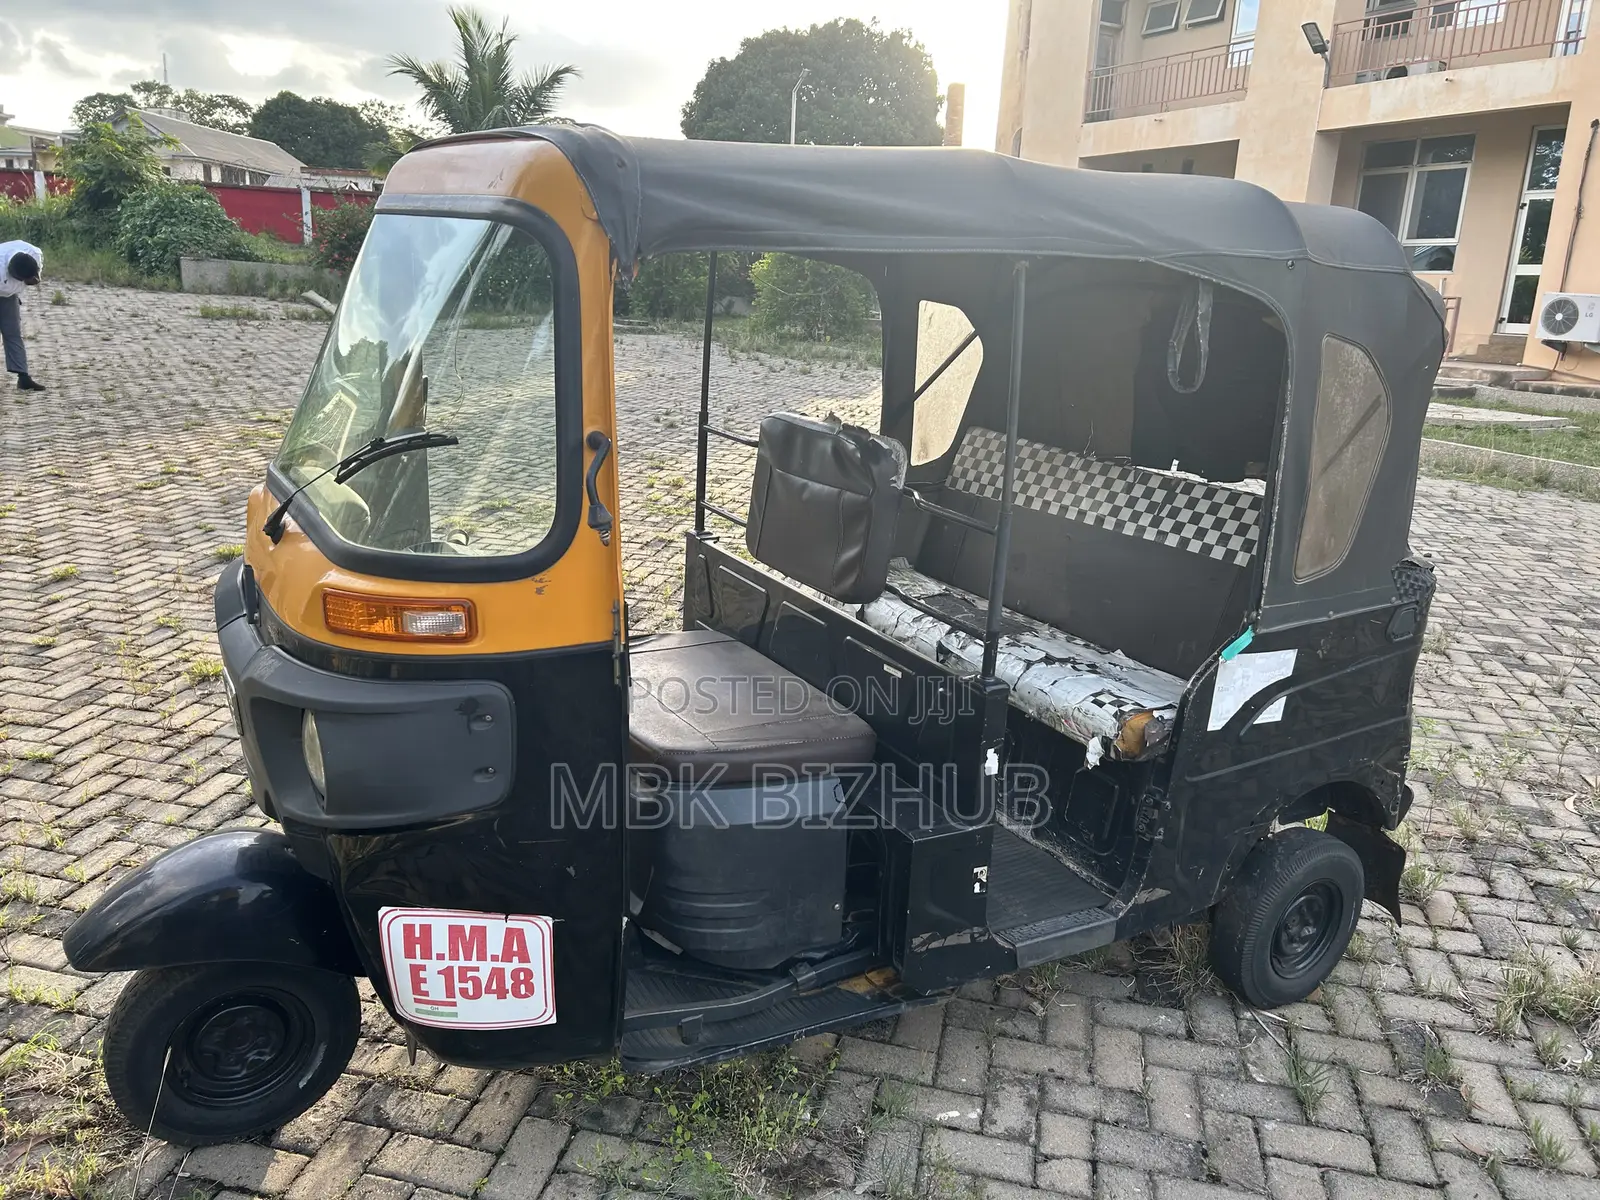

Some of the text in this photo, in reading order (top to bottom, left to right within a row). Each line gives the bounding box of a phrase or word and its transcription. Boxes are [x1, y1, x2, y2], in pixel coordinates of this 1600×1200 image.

[402, 923, 531, 963] H.M.A
[409, 963, 535, 1000] E 1548
